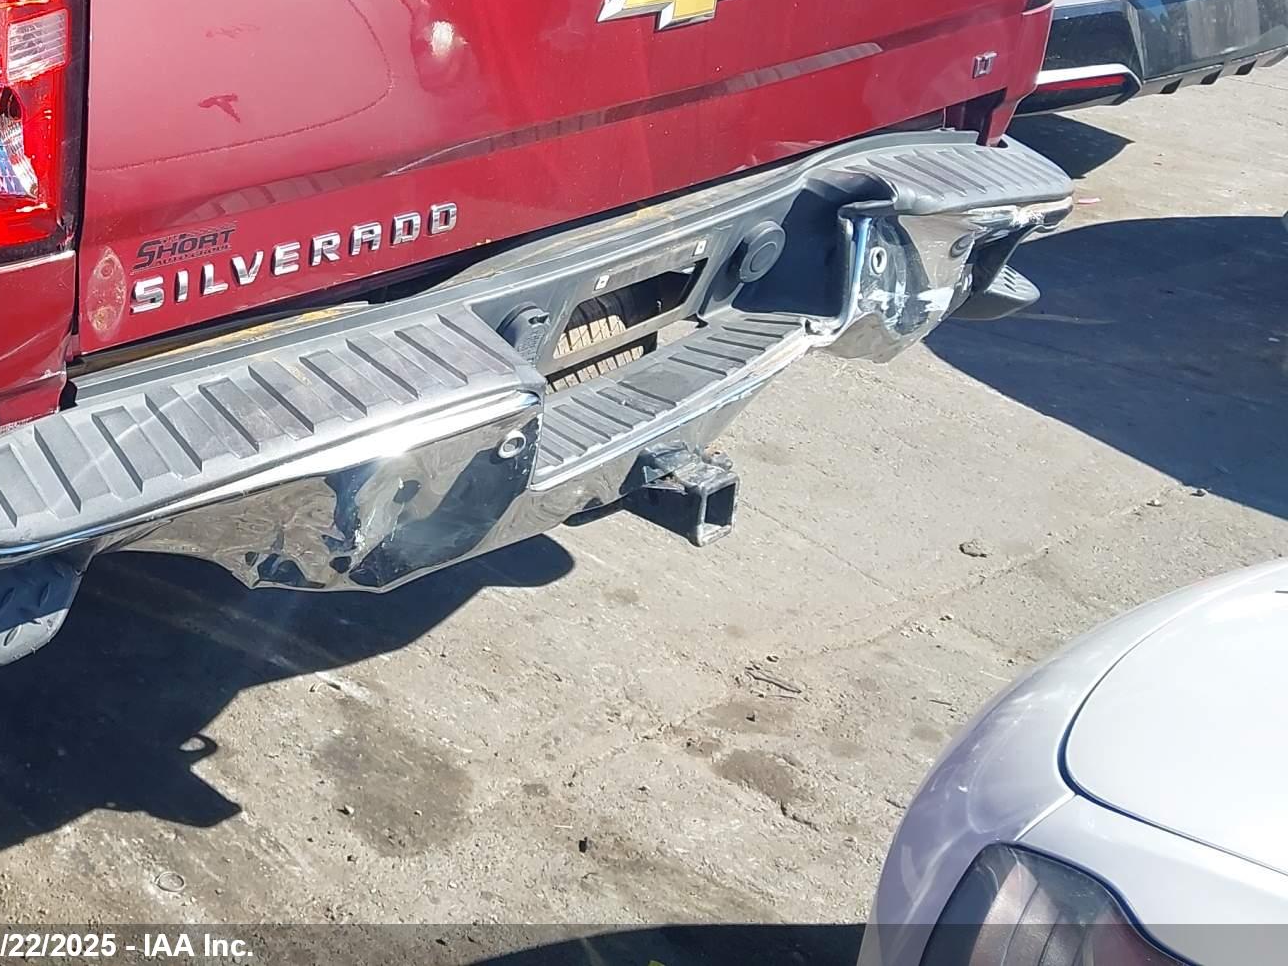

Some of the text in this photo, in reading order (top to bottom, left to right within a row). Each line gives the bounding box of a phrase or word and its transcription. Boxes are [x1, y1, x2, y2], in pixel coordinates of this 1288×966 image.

[972, 51, 998, 79] LT
[130, 202, 459, 314] SILVERADO
[132, 229, 236, 270] SHORT
